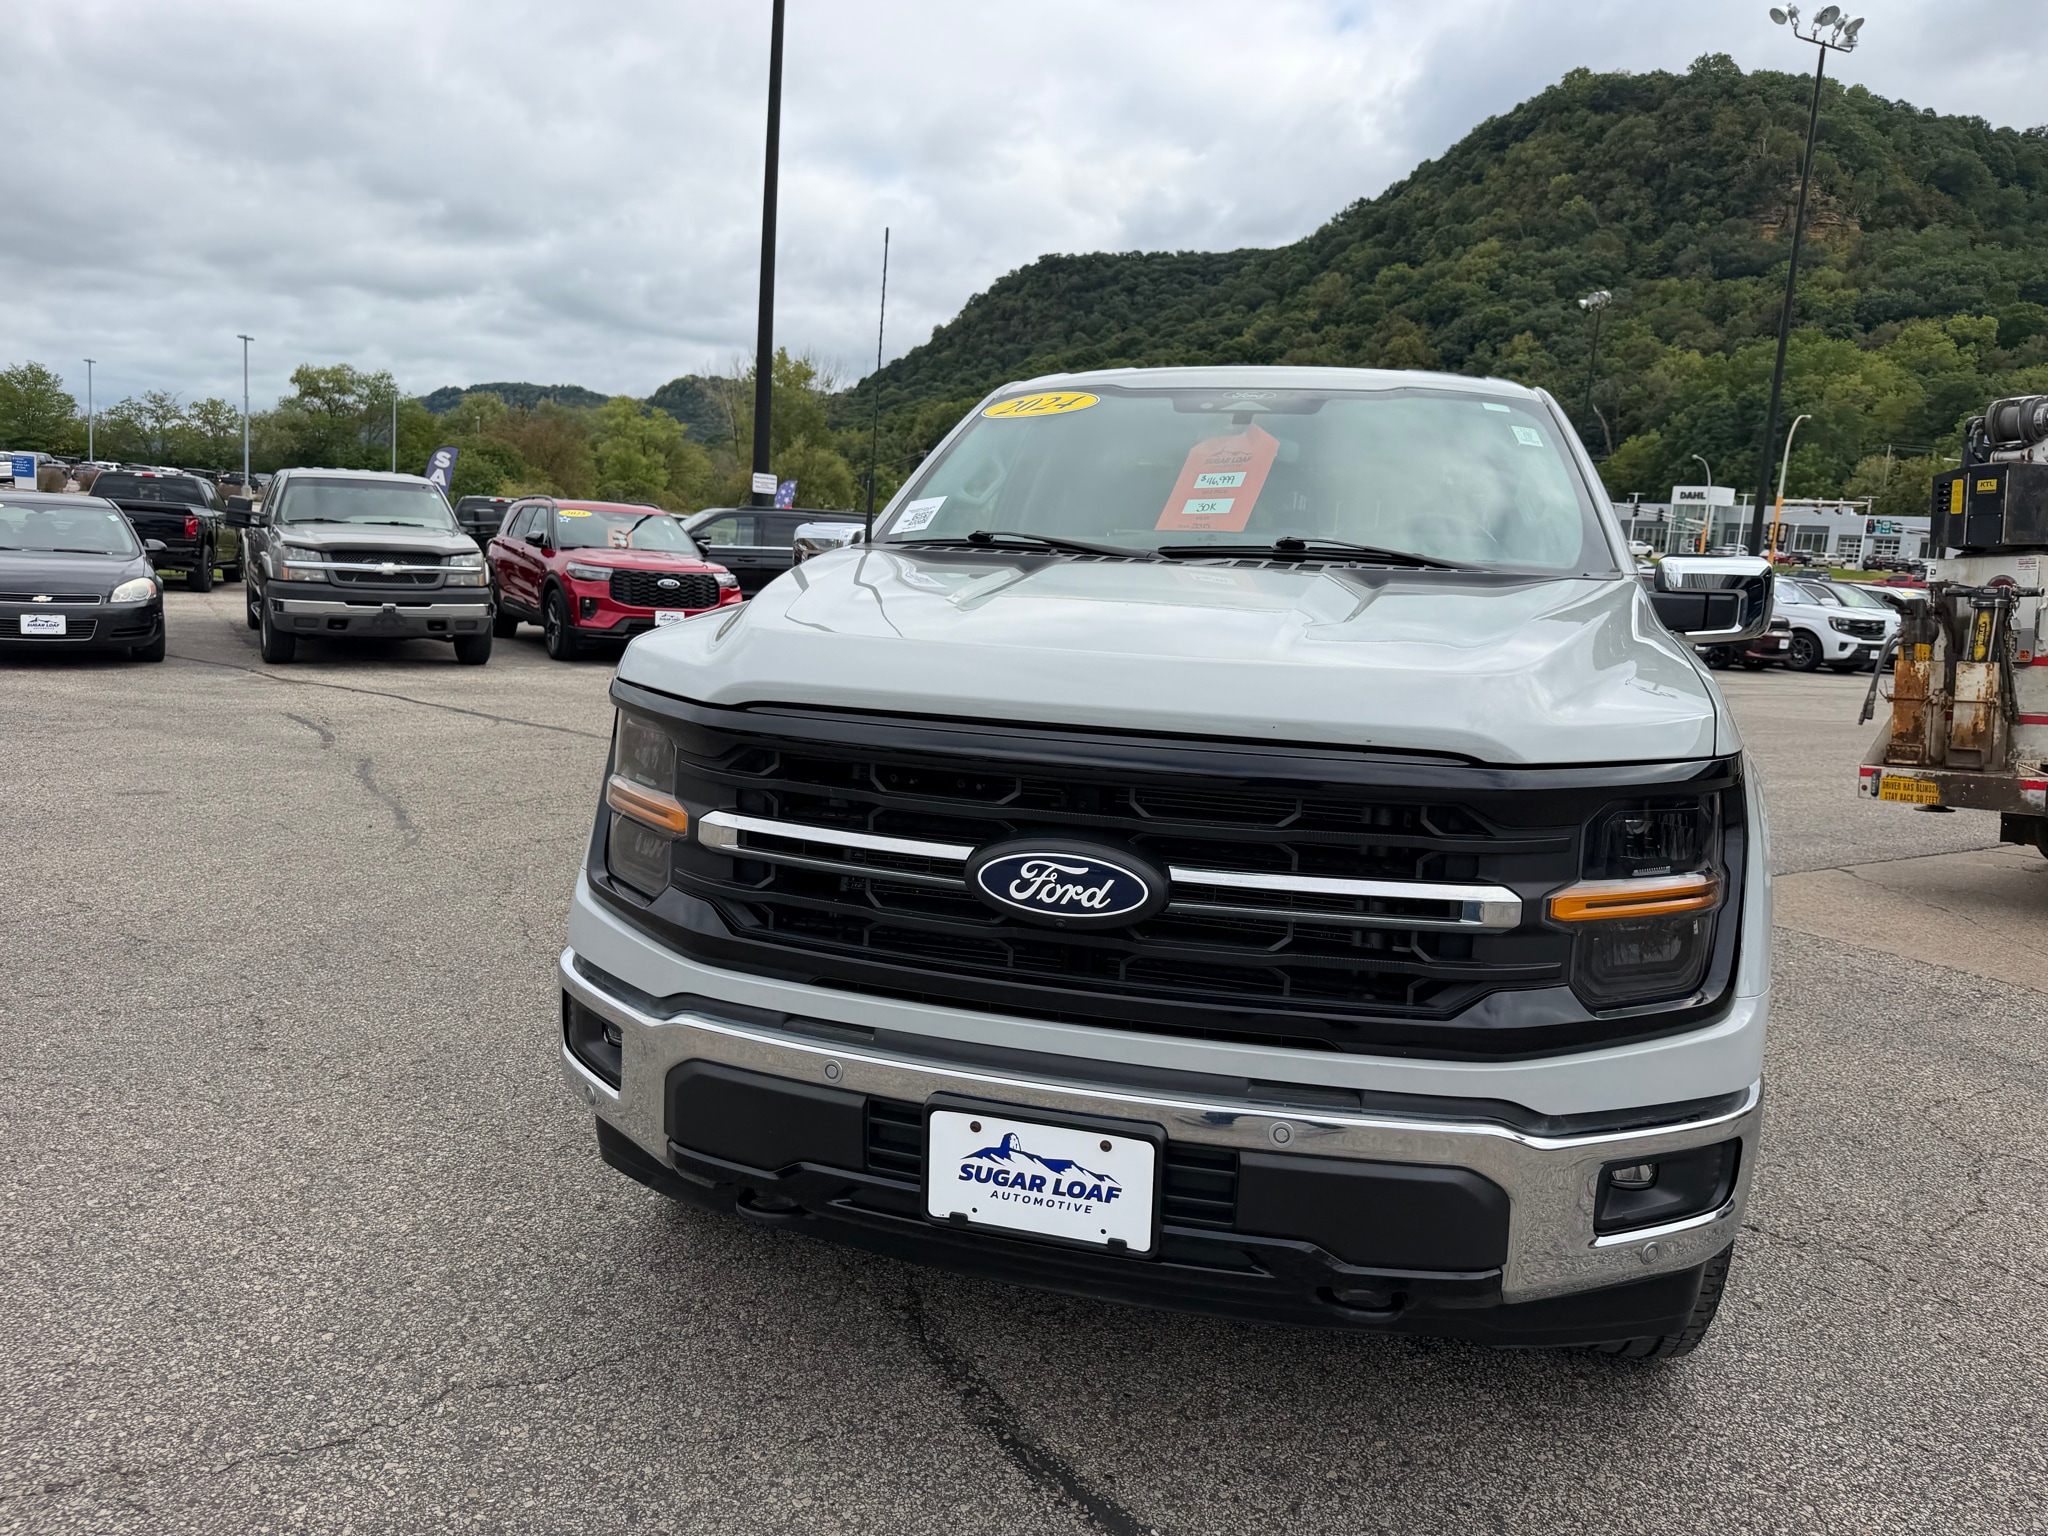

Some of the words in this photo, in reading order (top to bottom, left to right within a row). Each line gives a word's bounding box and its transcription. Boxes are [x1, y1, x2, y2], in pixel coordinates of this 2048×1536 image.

[993, 395, 1087, 416] 2024
[1200, 474, 1236, 486] $46,999
[1680, 491, 1706, 500] DAHL
[1196, 502, 1217, 513] 30K
[1903, 782, 1915, 792] HAS
[1885, 791, 1898, 801] STAY
[1899, 793, 1914, 802] BACK
[1916, 794, 1924, 803] 30
[1925, 795, 1939, 805] FEET
[1009, 860, 1115, 909] Ford
[958, 1163, 1047, 1193] SUGAR
[1052, 1178, 1122, 1204] LOAF
[990, 1190, 1094, 1214] AUTOMOTIVE
